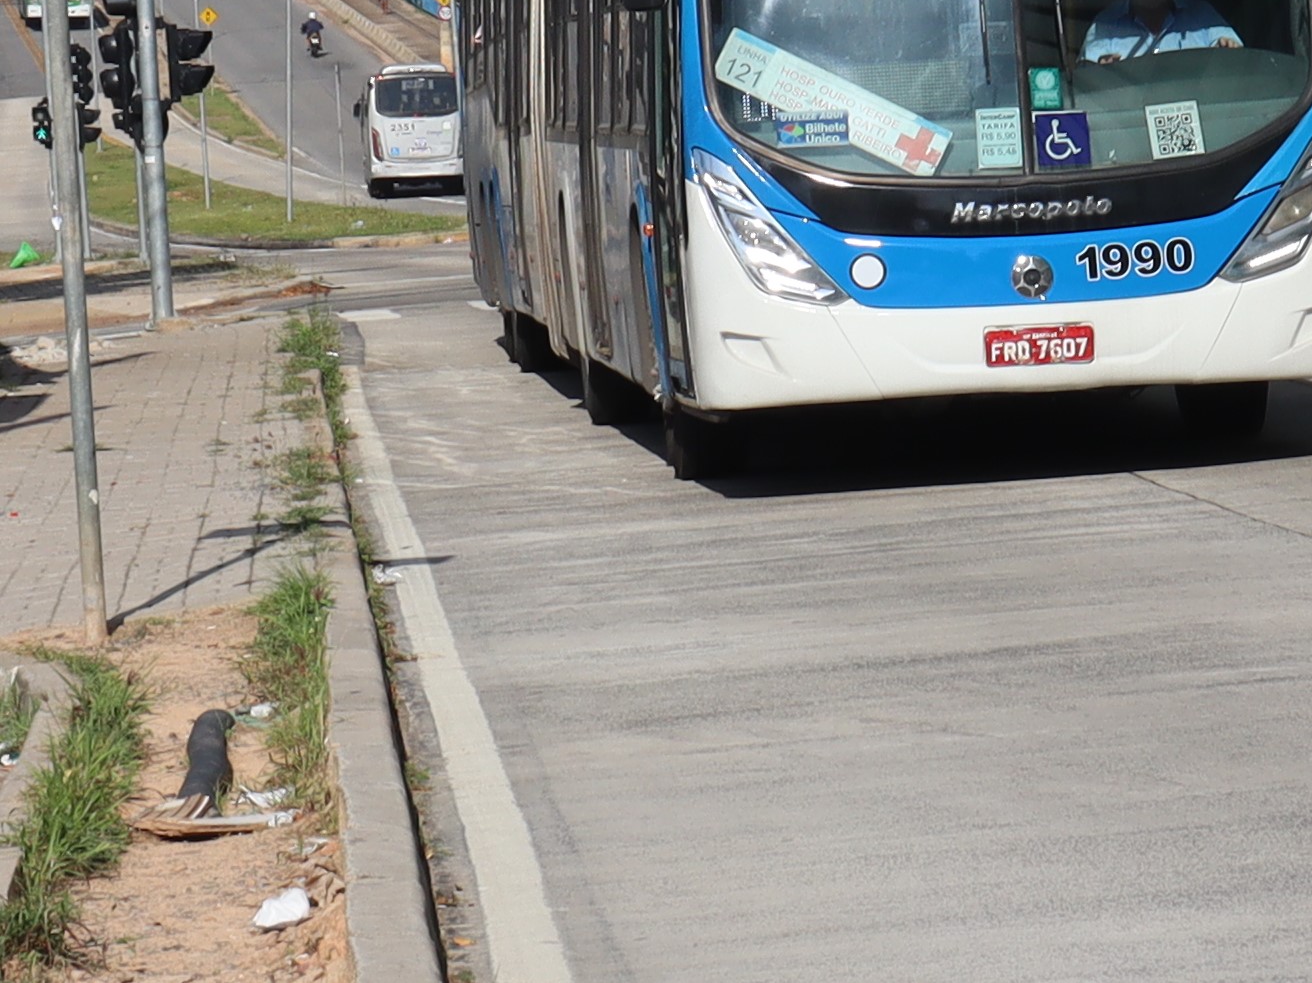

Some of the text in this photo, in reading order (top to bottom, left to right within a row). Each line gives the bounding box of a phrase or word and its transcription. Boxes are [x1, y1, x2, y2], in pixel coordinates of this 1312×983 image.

[737, 45, 768, 64] LINHA
[728, 57, 764, 89] 121
[775, 79, 809, 100] HOSP
[780, 66, 900, 129] HOSP OURO VERDE
[769, 90, 804, 112] HOSP
[852, 131, 901, 159] RIBEIRO
[780, 111, 845, 123] UTILIZE AQUI
[805, 122, 847, 134] Bilhete
[981, 123, 1016, 131] TARIFA
[951, 196, 1112, 224] Marcopolo
[1076, 237, 1195, 282] 1990
[1038, 336, 1088, 361] 7607
